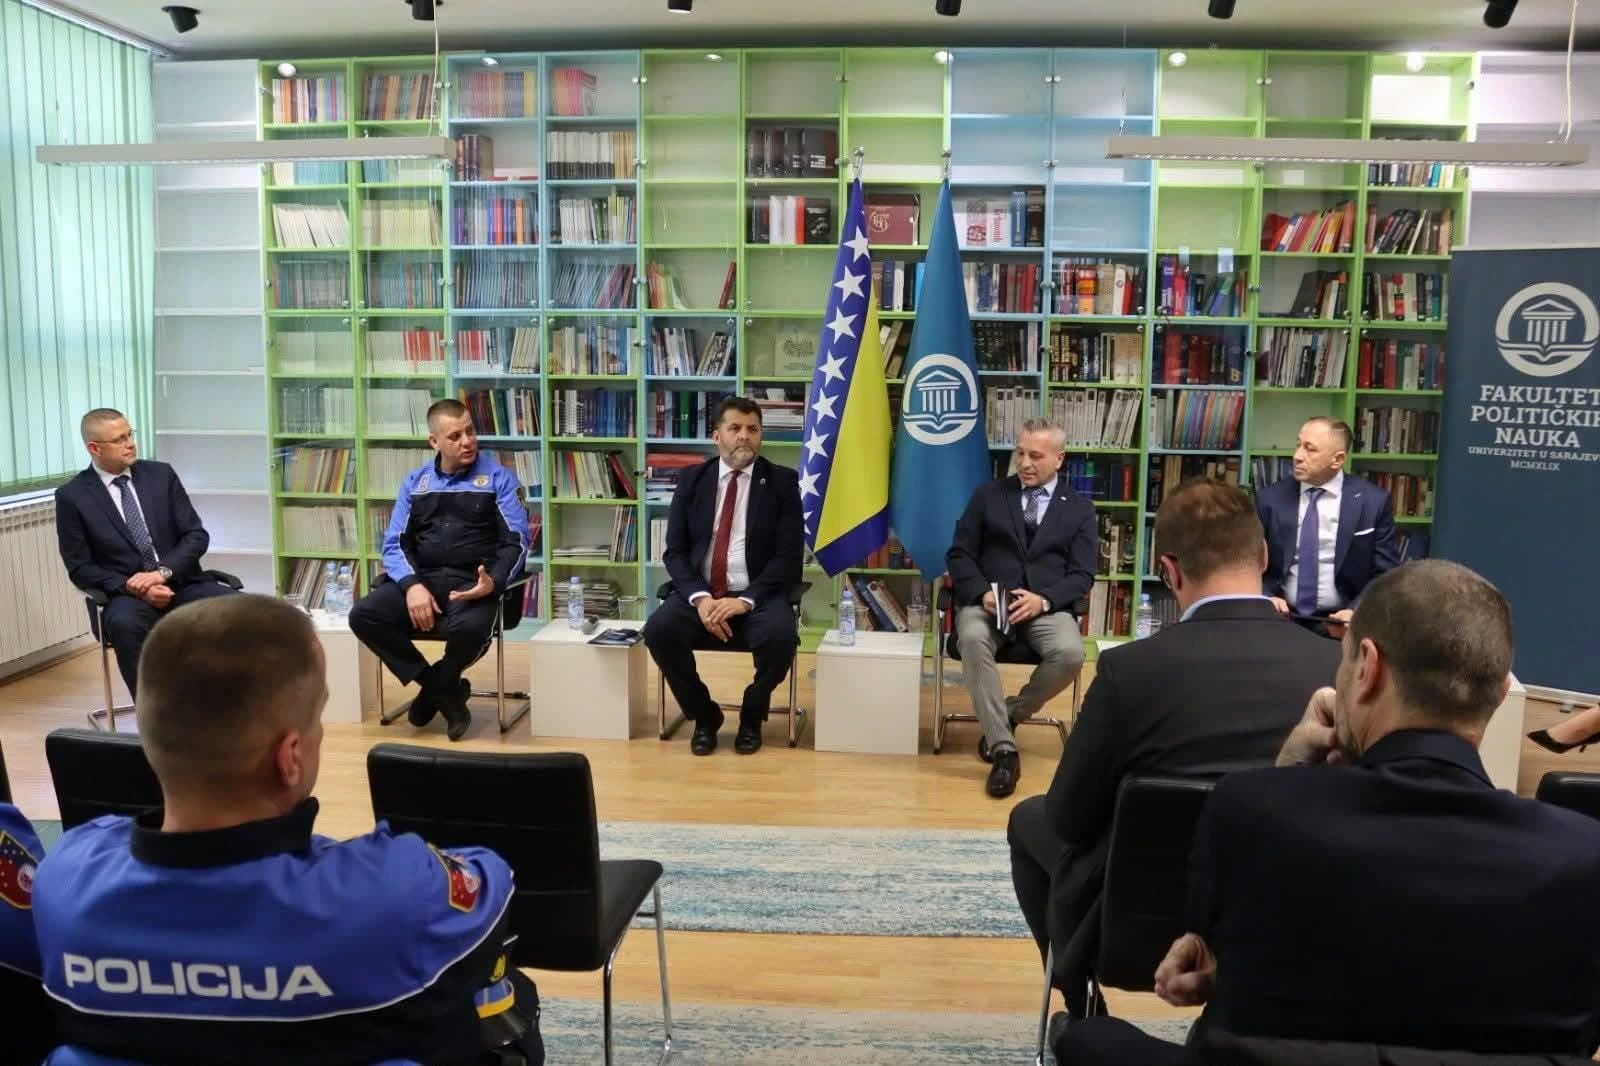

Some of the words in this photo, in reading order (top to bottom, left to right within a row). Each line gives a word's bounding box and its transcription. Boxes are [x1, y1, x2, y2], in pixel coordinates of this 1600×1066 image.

[1480, 384, 1600, 405] FAKULTET
[1494, 427, 1580, 448] NAUKA
[1468, 446, 1536, 458] UNIVERZITET
[1539, 451, 1548, 459] U
[1550, 451, 1600, 462] SARAJEV
[1511, 460, 1560, 471] MCMXLIX
[63, 952, 334, 1001] POLICIJA
